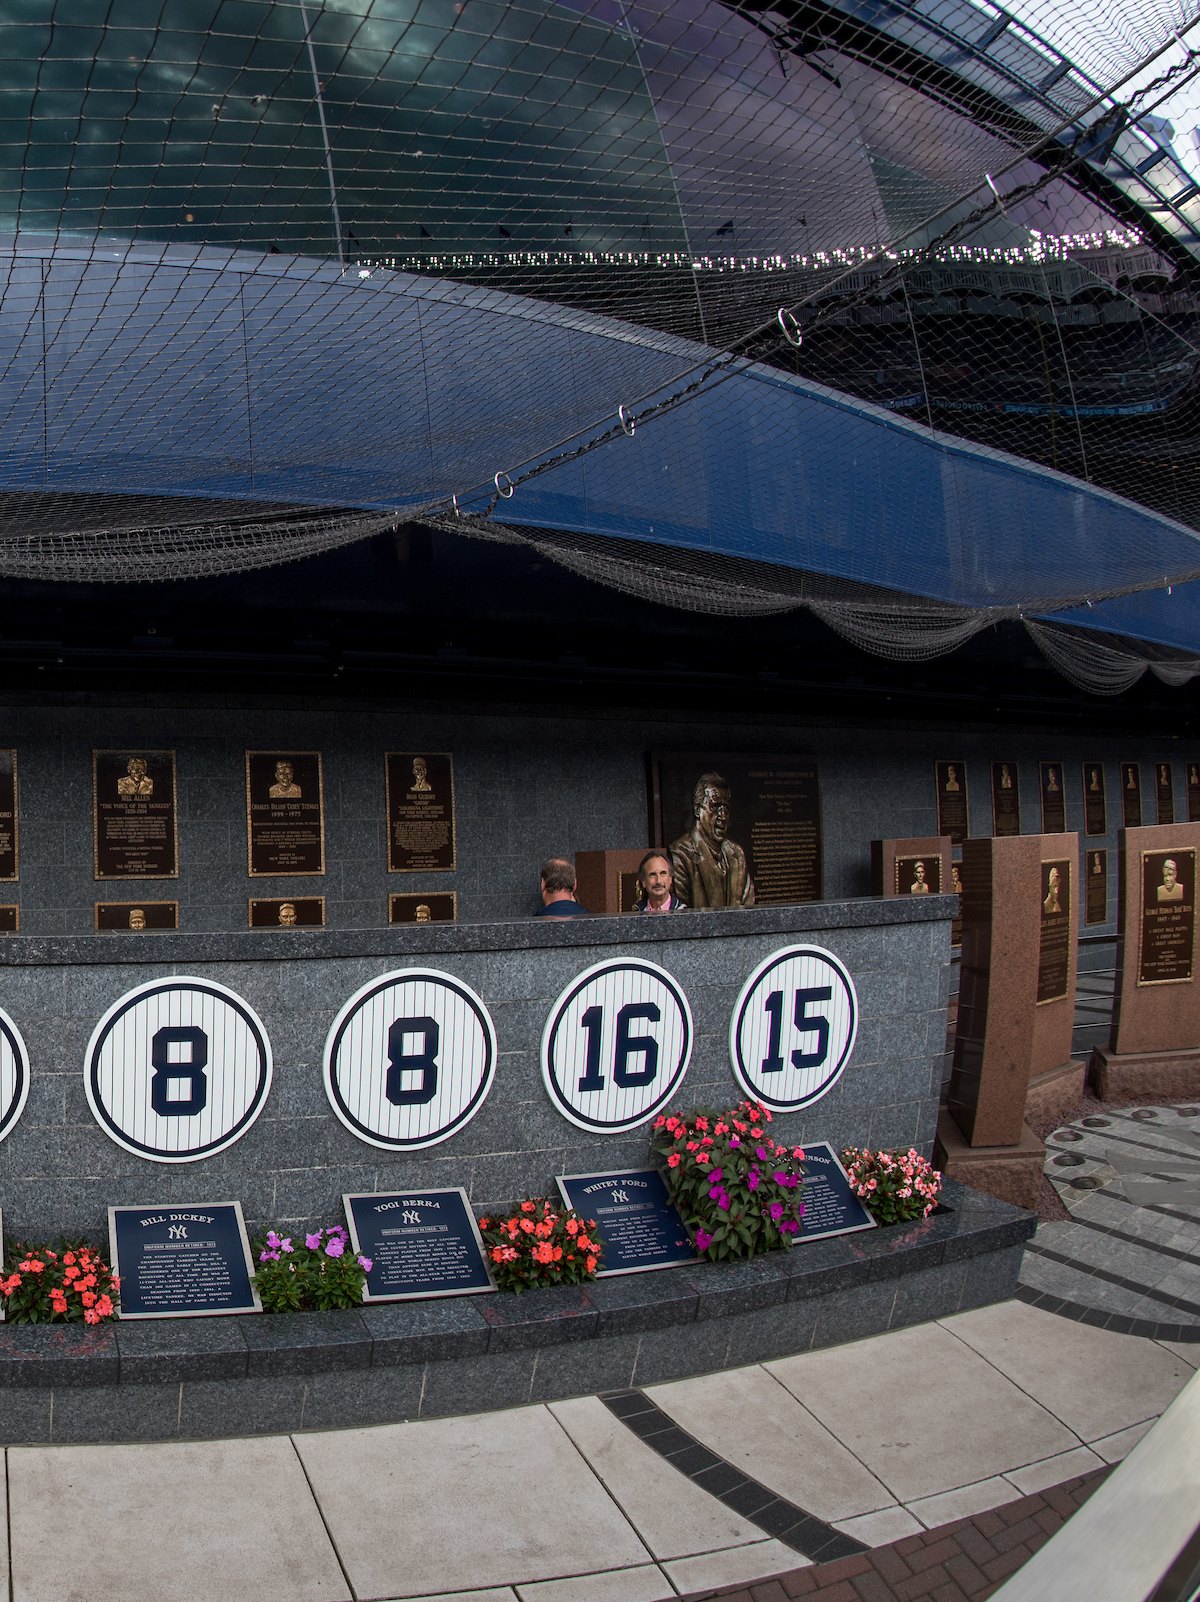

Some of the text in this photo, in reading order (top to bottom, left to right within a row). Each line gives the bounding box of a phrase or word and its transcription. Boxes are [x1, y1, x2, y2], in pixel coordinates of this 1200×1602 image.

[152, 1026, 208, 1116] 8
[386, 1016, 439, 1106] 8
[579, 1002, 661, 1092] 16
[762, 986, 832, 1074] 15
[140, 1213, 215, 1227] BILL DICKEY
[374, 1200, 441, 1213] YOGI BERRA
[583, 1180, 648, 1194] WHITEY FORD
